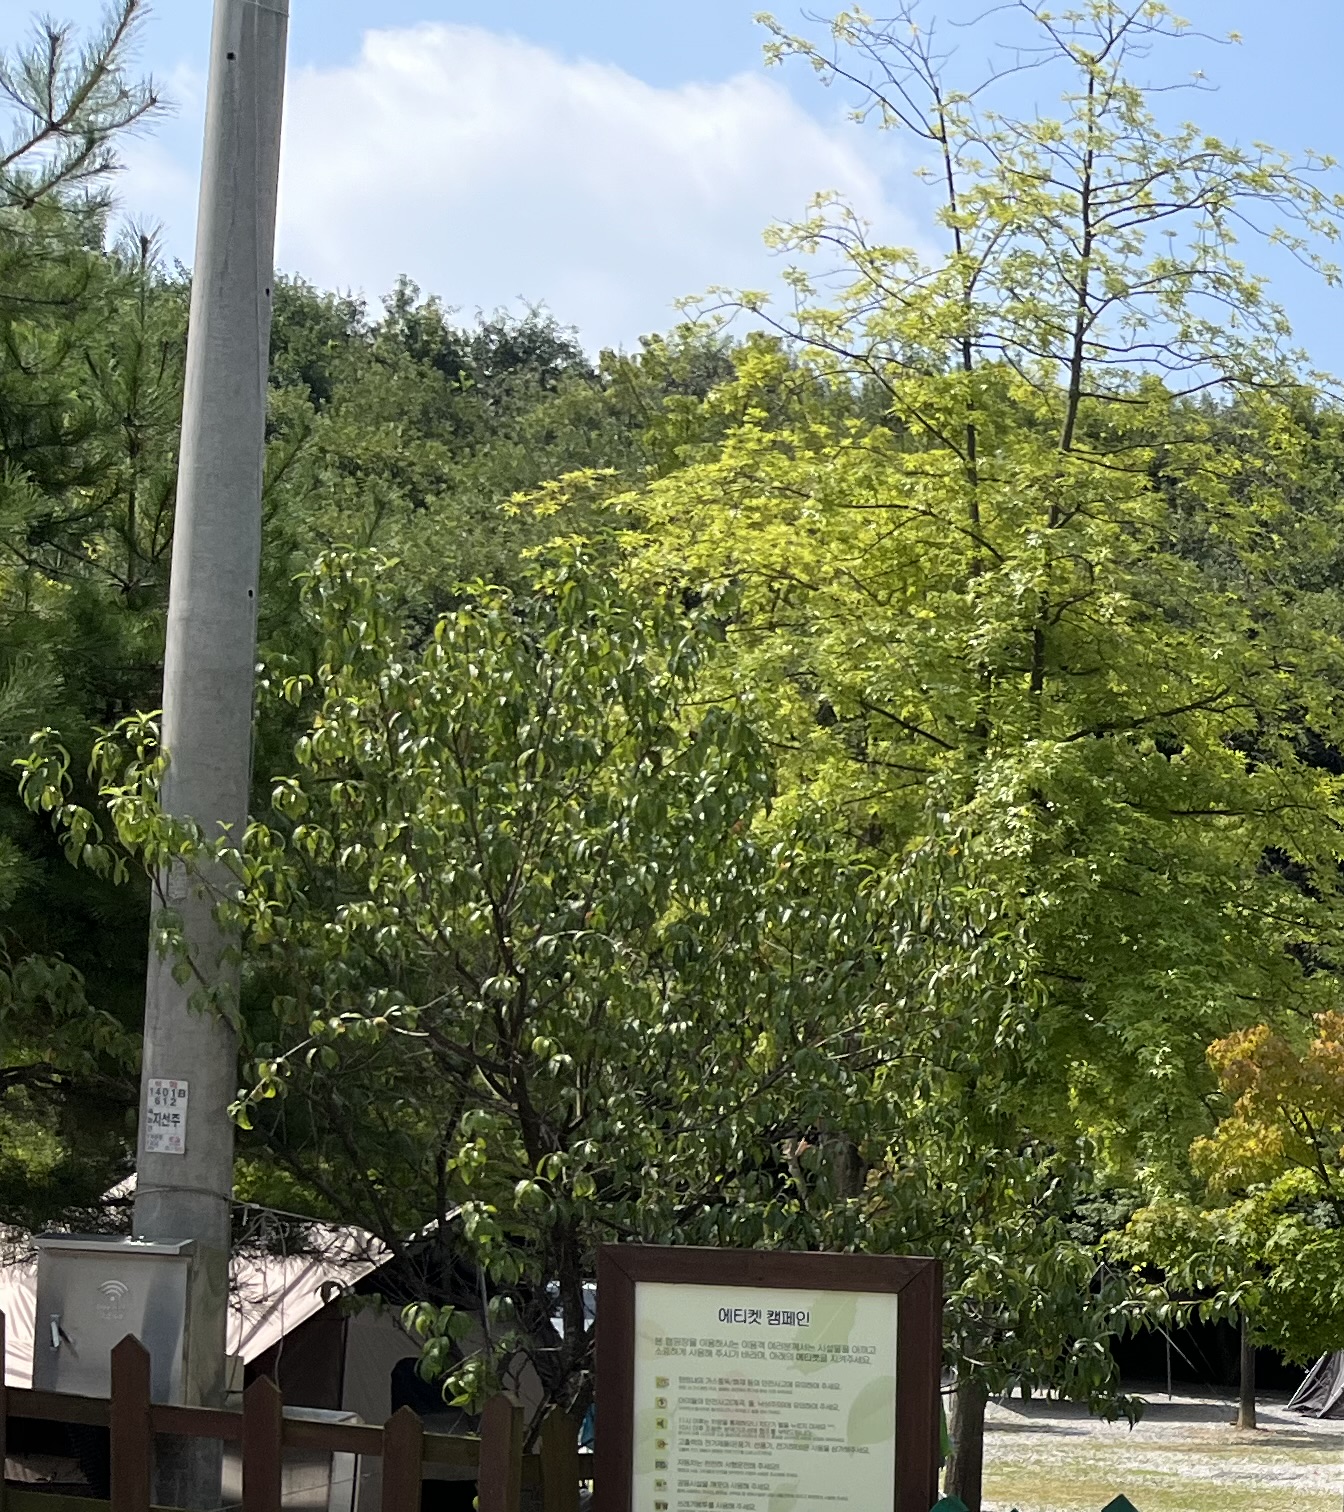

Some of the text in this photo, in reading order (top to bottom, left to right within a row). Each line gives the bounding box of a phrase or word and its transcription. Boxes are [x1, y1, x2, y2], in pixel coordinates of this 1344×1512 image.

[150, 1088, 186, 1098] 1401B
[154, 1097, 177, 1106] 612
[718, 1308, 810, 1327] 에티켓 캠페인
[700, 1339, 738, 1349] 이용하시는
[688, 1348, 712, 1358] 사용해
